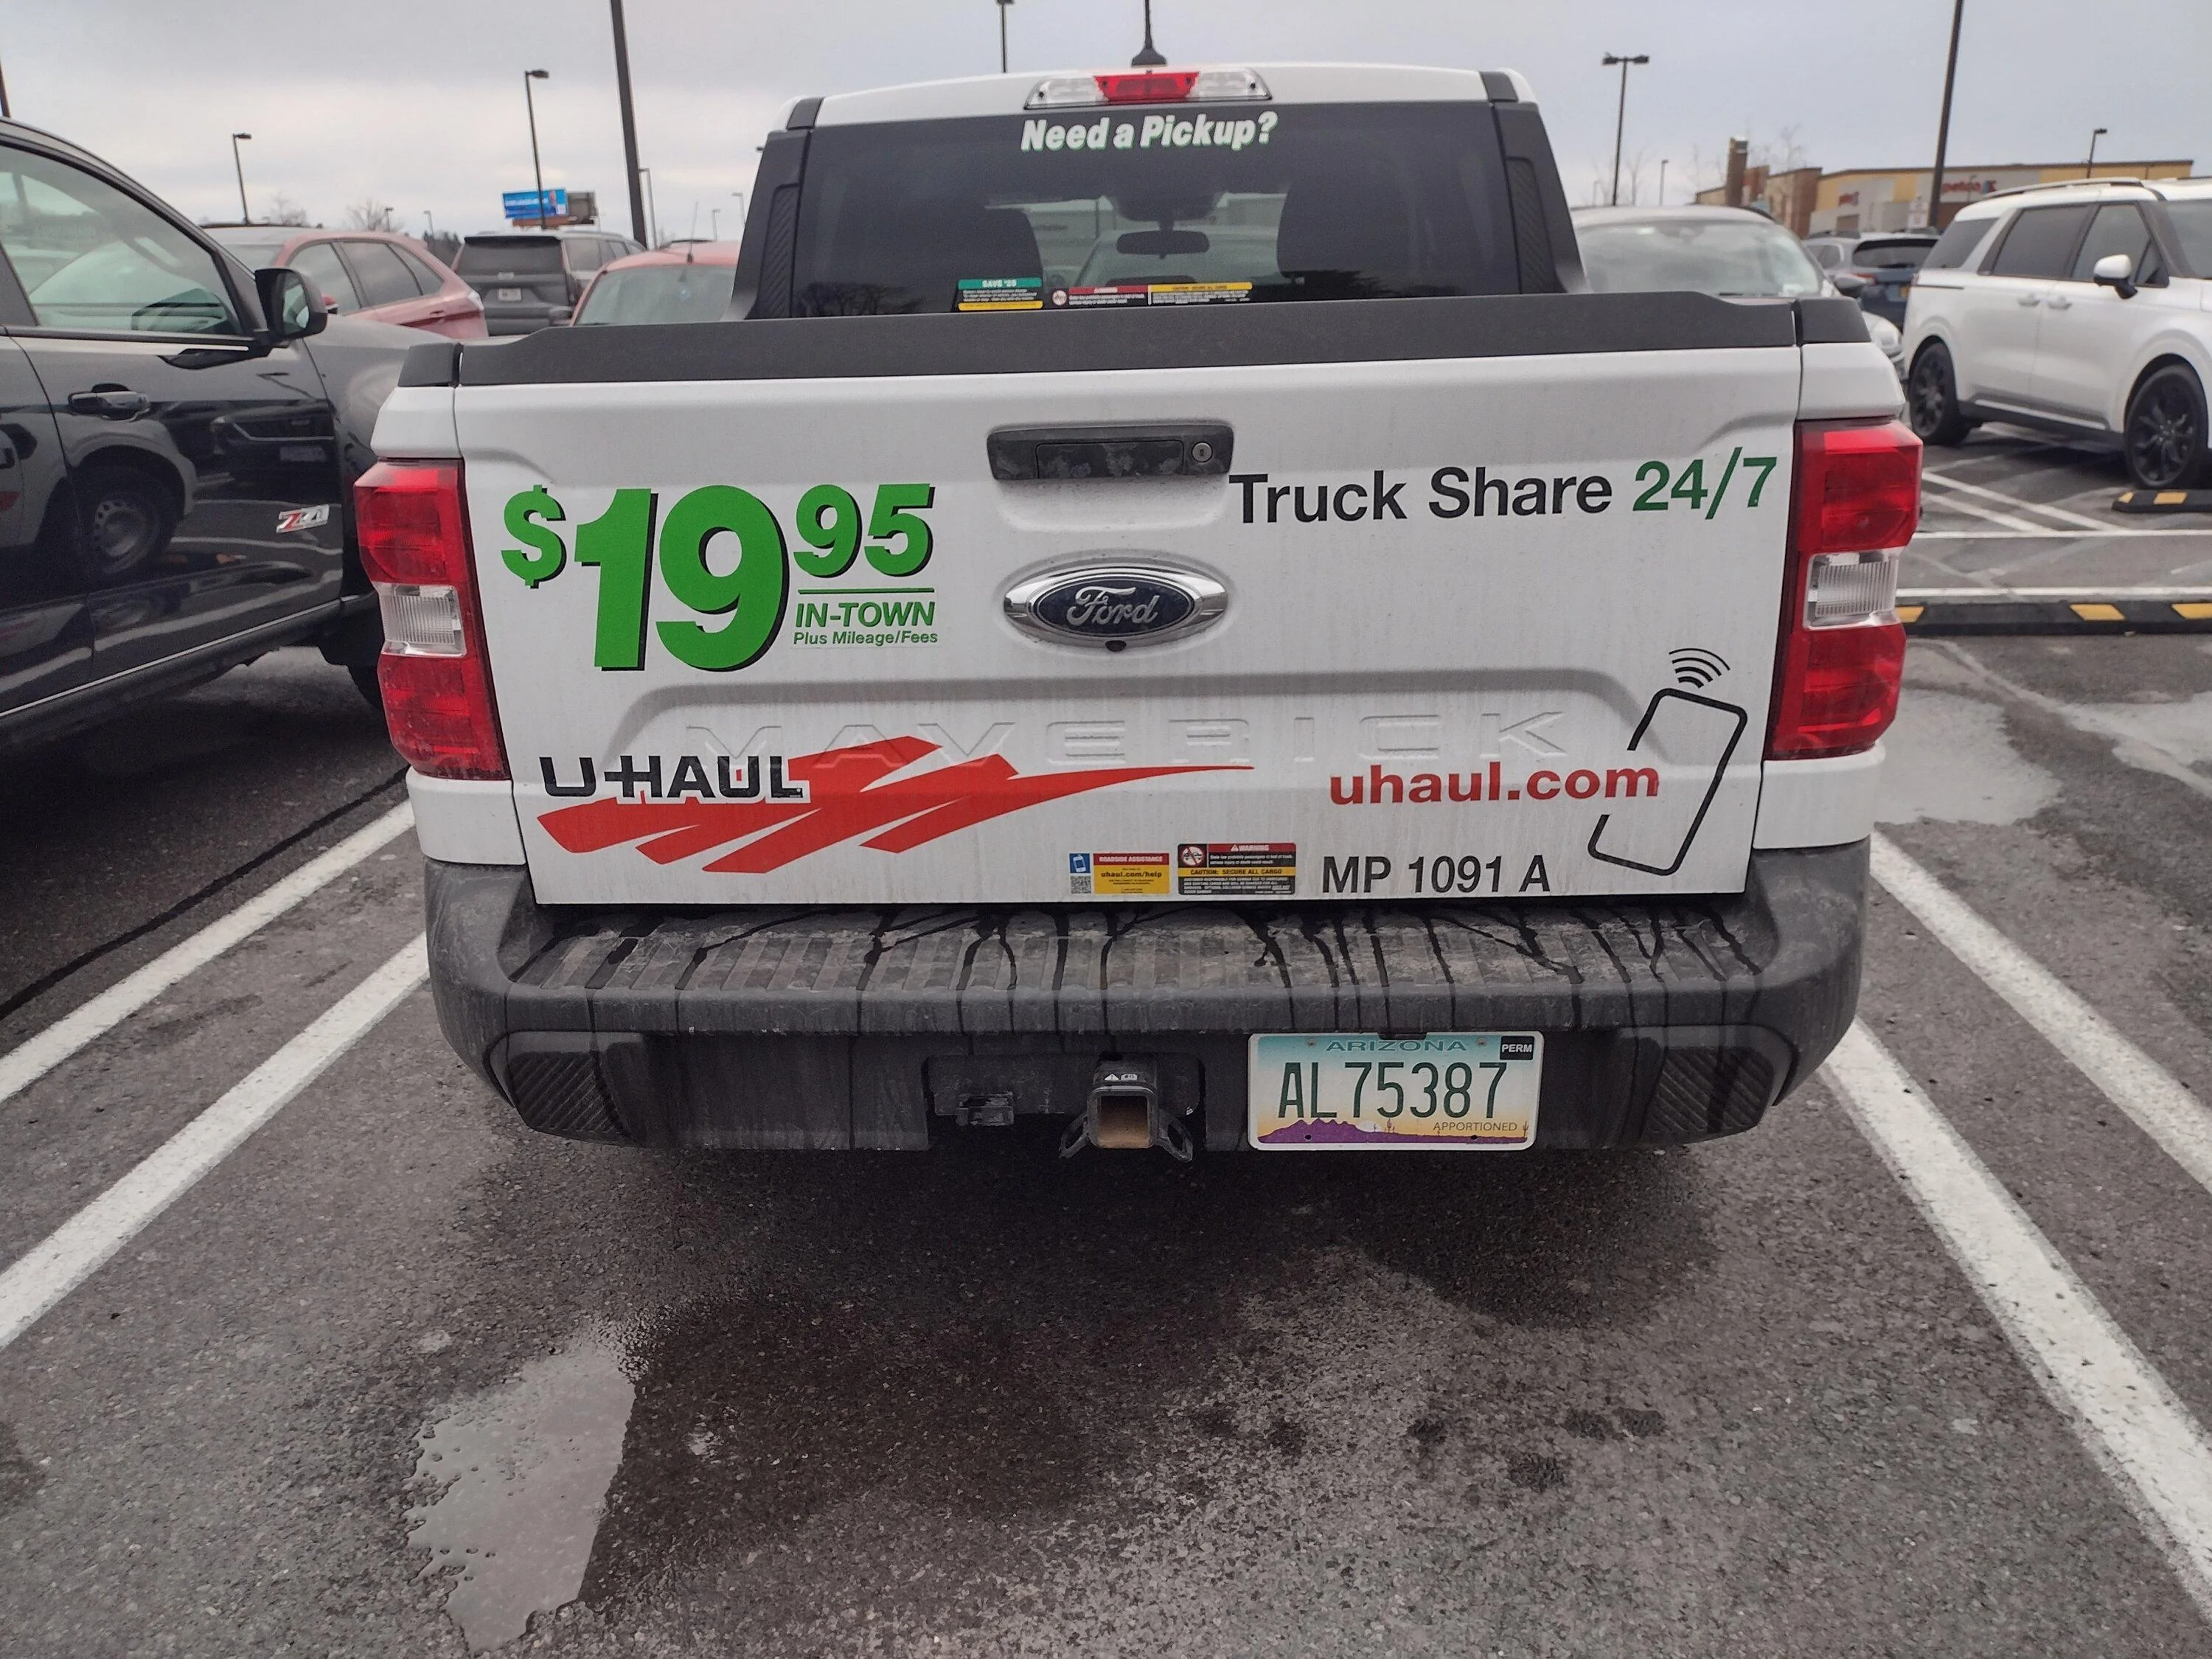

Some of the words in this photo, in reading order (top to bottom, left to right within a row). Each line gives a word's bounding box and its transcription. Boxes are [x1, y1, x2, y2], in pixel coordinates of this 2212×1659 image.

[1020, 117, 1110, 151] Need
[1113, 123, 1135, 150] a
[1140, 111, 1279, 151] Pickup?
[1229, 470, 1408, 524] Truck
[1428, 466, 1613, 518] Share
[1632, 447, 1778, 521] 24/7
[796, 601, 936, 627] IN-TOWN
[1066, 586, 1160, 625] Ford
[793, 631, 828, 644] Plus
[832, 630, 939, 647] Mileage/Fees
[686, 711, 1568, 768] MAVERICK
[539, 755, 804, 799] U-HAUL
[1330, 762, 1660, 805] uhaul.com
[1322, 856, 1391, 894] MP
[1408, 855, 1502, 893] 1091
[1519, 855, 1551, 893] A
[1326, 1039, 1467, 1052] ARIZONA
[1501, 1044, 1533, 1052] PERM
[1278, 1062, 1507, 1119] AL75387
[1433, 1121, 1518, 1131] APPORTIONED
